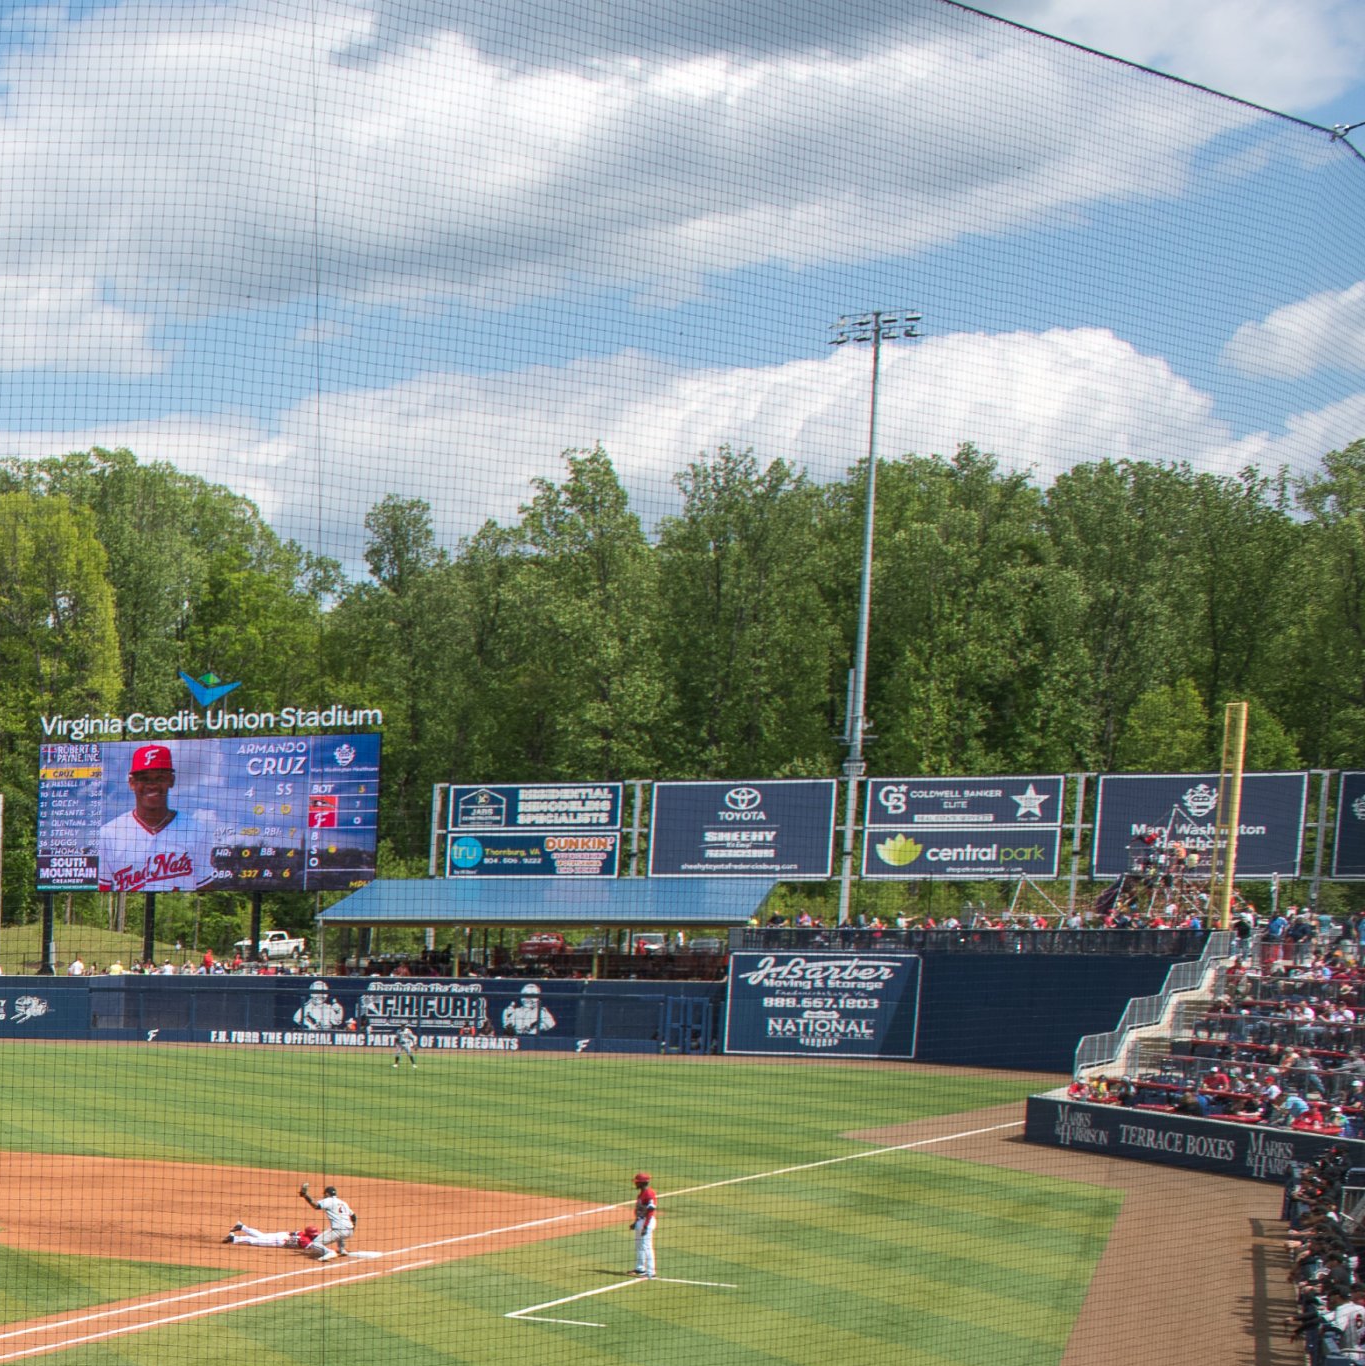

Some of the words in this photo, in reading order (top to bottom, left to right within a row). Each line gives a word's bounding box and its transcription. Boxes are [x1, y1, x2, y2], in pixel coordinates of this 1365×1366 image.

[41, 713, 122, 740] Virginia
[128, 711, 198, 734] Credit
[207, 709, 274, 731] Union
[278, 704, 383, 728] Stadium
[237, 742, 307, 754] ARMANDO
[247, 757, 308, 776] CRUZ
[910, 789, 961, 798] COLDWELL
[963, 789, 1003, 798] BANKER
[718, 811, 767, 821] TOYOTA
[704, 831, 777, 842] SHEEHY
[545, 837, 615, 851] DUNKIN'
[926, 844, 998, 861] central
[1000, 844, 1045, 864] park
[50, 857, 87, 867] SOUTH
[763, 978, 812, 989] Moving
[827, 979, 884, 990] Storage
[420, 996, 479, 1018] FURR
[769, 1020, 874, 1033] NATIONAL
[211, 1031, 228, 1042] F.H.
[230, 1032, 259, 1043] FURR
[262, 1032, 282, 1043] THE
[284, 1032, 332, 1045] OFFICIAL
[335, 1033, 365, 1046] HVAC
[420, 1036, 434, 1048] OF
[436, 1036, 458, 1049] THE
[460, 1037, 518, 1050] FREDNATS
[1120, 1124, 1184, 1153] TERRACE
[1186, 1136, 1235, 1161] BOXES
